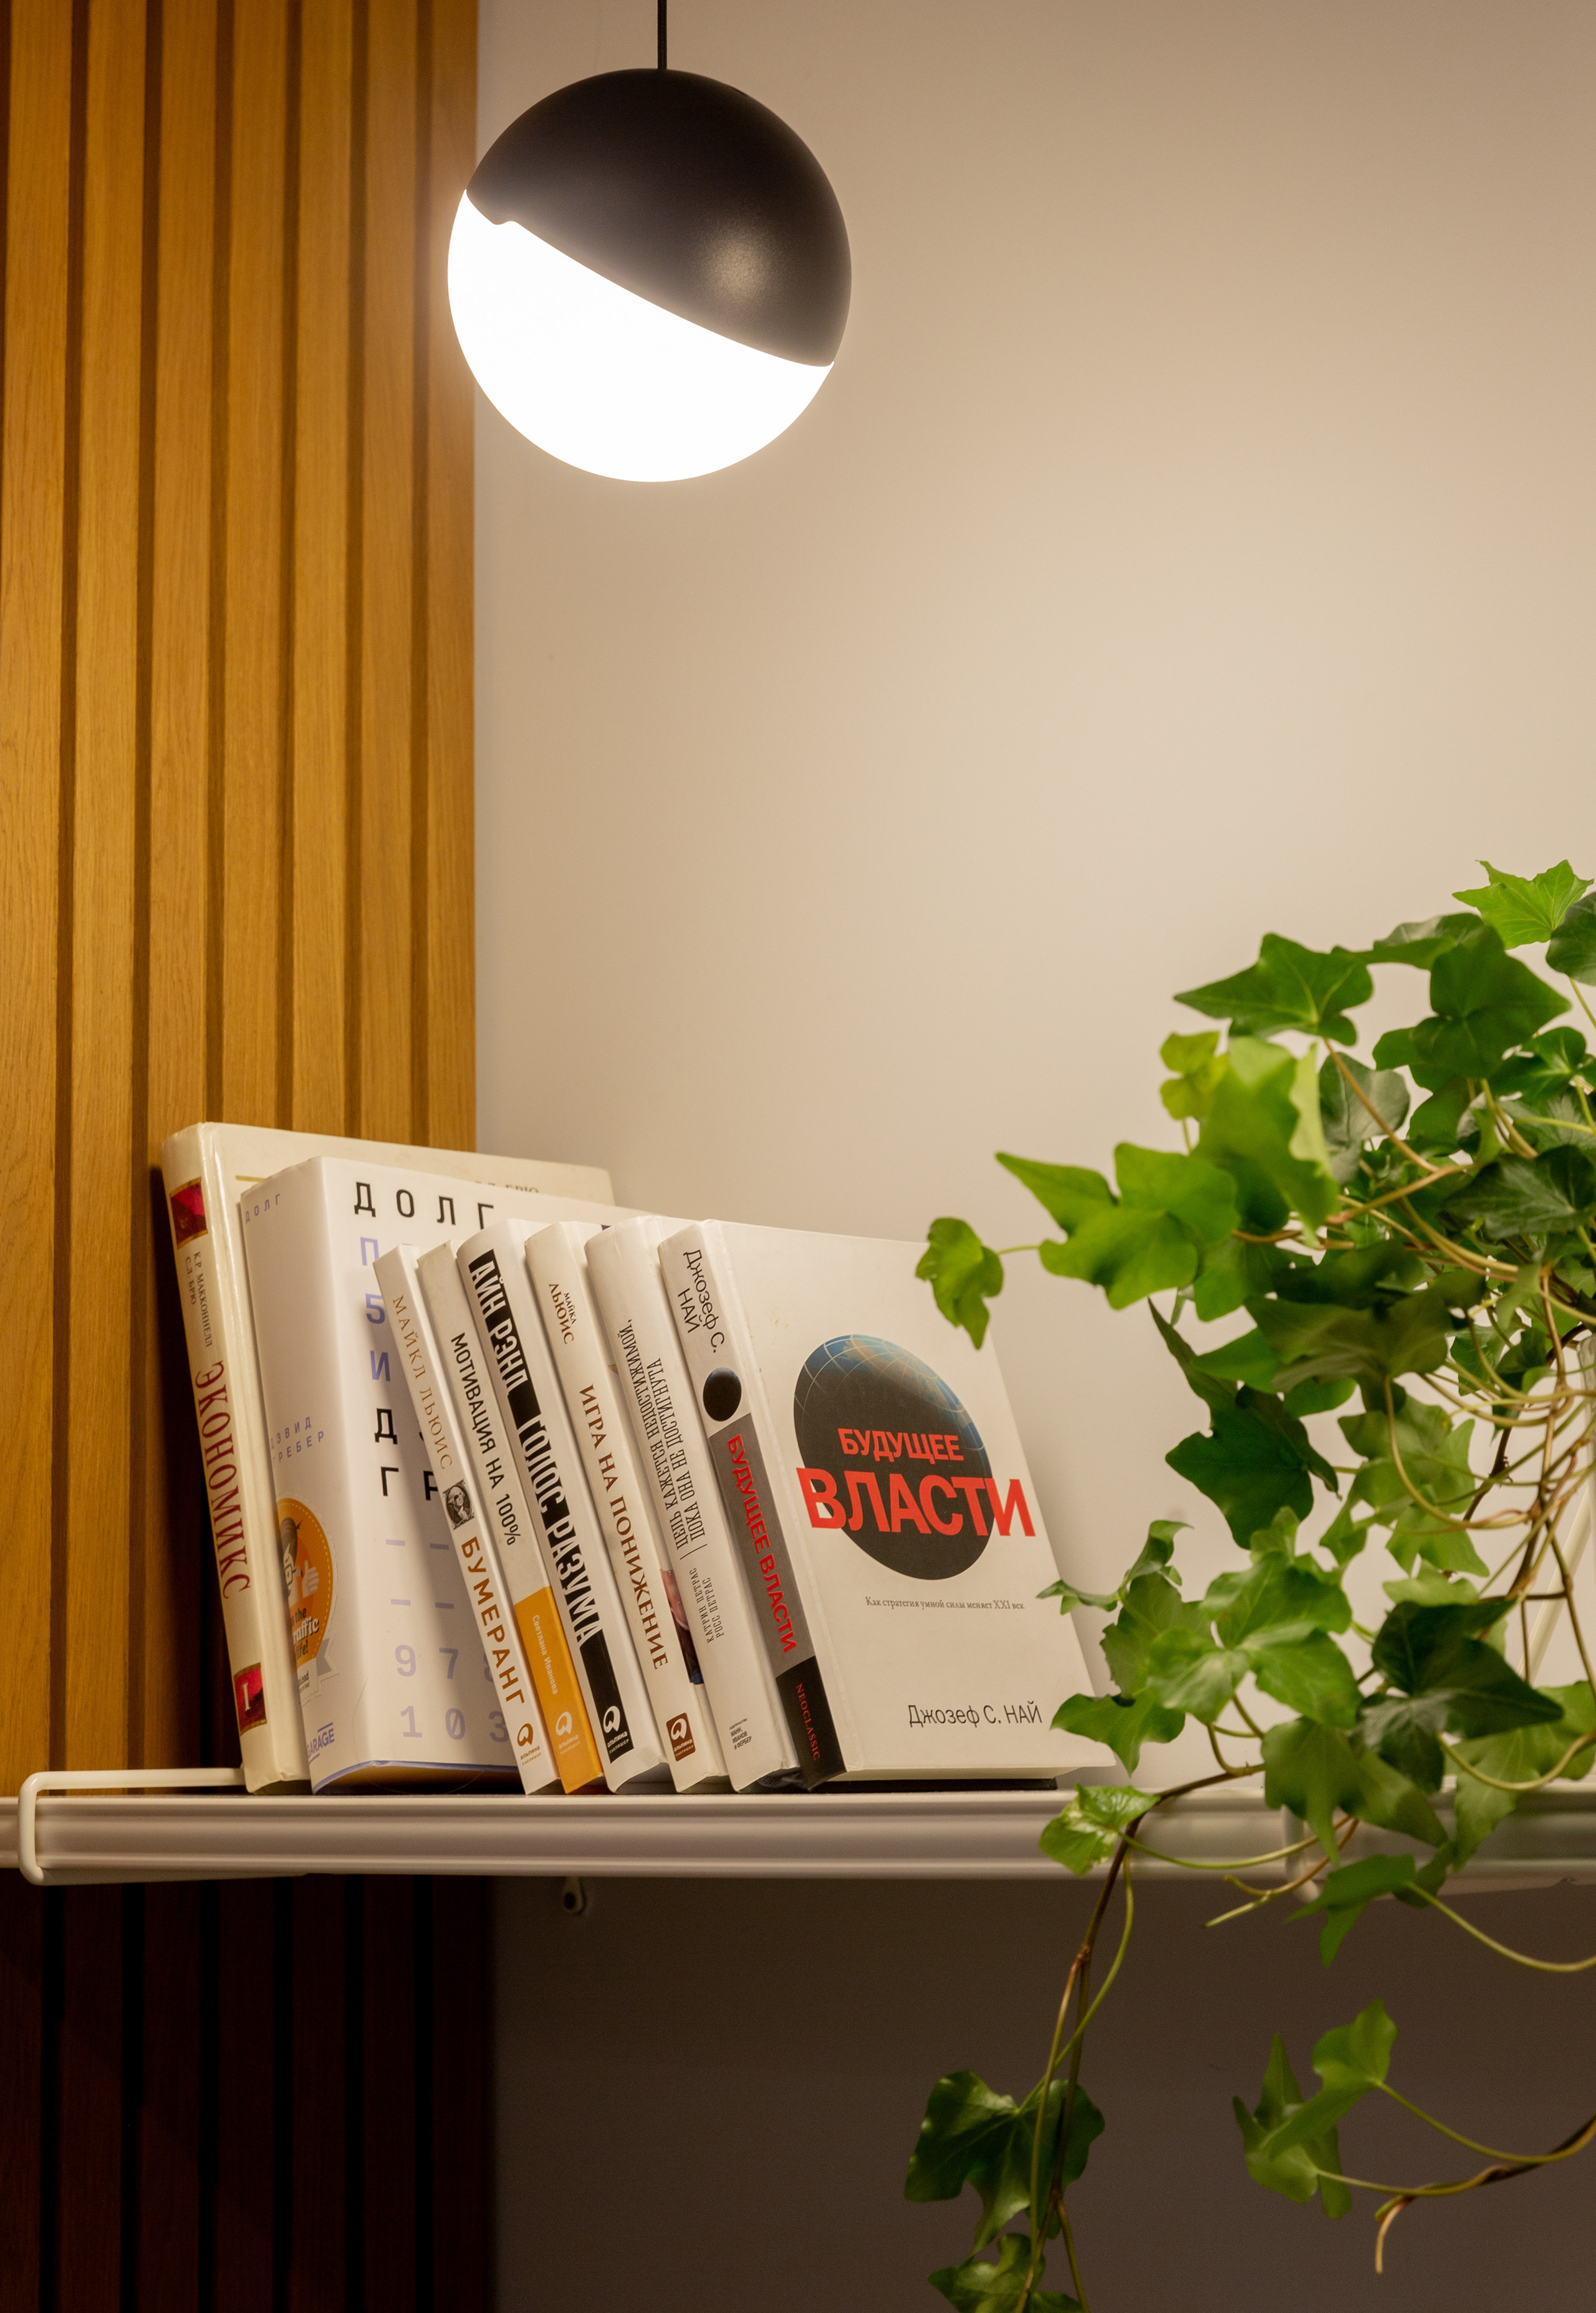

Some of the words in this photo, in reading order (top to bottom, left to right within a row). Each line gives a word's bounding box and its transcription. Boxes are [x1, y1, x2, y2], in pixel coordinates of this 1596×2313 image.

[245, 1193, 282, 1223] ДОЛГ
[354, 1181, 494, 1229] ДОЛГ
[188, 1280, 197, 1305] БРЮ
[196, 1273, 213, 1347] МАККОННЕЛЛ
[549, 1283, 574, 1344] ЛЬЮИС
[678, 1287, 703, 1334] НАЙ
[683, 1249, 719, 1330] Джозеф
[710, 1331, 724, 1354] С.
[393, 1295, 426, 1379] МАЙКЛ
[419, 1386, 453, 1470] ЛЬЮИС
[617, 1319, 660, 1440] НЕДОСТИЖИМОЙ,
[647, 1357, 684, 1450] ДОСТИГНУТА
[271, 1416, 312, 1450] ДЭВИД
[450, 1332, 496, 1455] МОТИВАЦИЯ
[486, 1457, 505, 1490] НА
[496, 1494, 521, 1546] 100%
[470, 1260, 506, 1315] АЙН
[489, 1317, 528, 1395] РЭНД
[518, 1414, 566, 1513] ГОЛОС
[547, 1518, 603, 1647] РАЗУМА
[670, 1448, 688, 1471] НЕ
[838, 1428, 964, 1464] БУДУЩЕЕ
[195, 1360, 251, 1599] ЭКОНОМИКС
[650, 1439, 678, 1511] КАЖЕТСЯ
[676, 1469, 695, 1502] ОНА
[796, 1467, 1036, 1537] ВЛАСТИ
[579, 1383, 607, 1450] ИГРА
[598, 1451, 619, 1493] НА
[610, 1494, 669, 1670] ПОНИЖЕНИЕ
[669, 1510, 688, 1551] ЦЕЛЬ
[684, 1501, 705, 1542] ПОКА
[727, 1433, 771, 1554] БУДУЩЕЕ
[759, 1553, 797, 1653] ВЛАСТИ
[689, 1567, 704, 1604] ПЕТРАС
[702, 1577, 718, 1612] ПЕТРАС
[865, 1596, 882, 1606] Как
[882, 1599, 919, 1609] стратегия
[920, 1600, 945, 1610] умной
[993, 1600, 1011, 1609] XXI
[461, 1536, 525, 1706] БУМЕРАНГ
[698, 1607, 714, 1644] КАТРИН
[711, 1614, 724, 1639] РОСС
[532, 1614, 547, 1656] Светлана
[544, 1656, 558, 1695] Иванова
[796, 1683, 820, 1761] NEOCLASSIC
[908, 1705, 980, 1728] Джозеф
[983, 1705, 1001, 1724] С.
[1004, 1700, 1042, 1724] НАЙ
